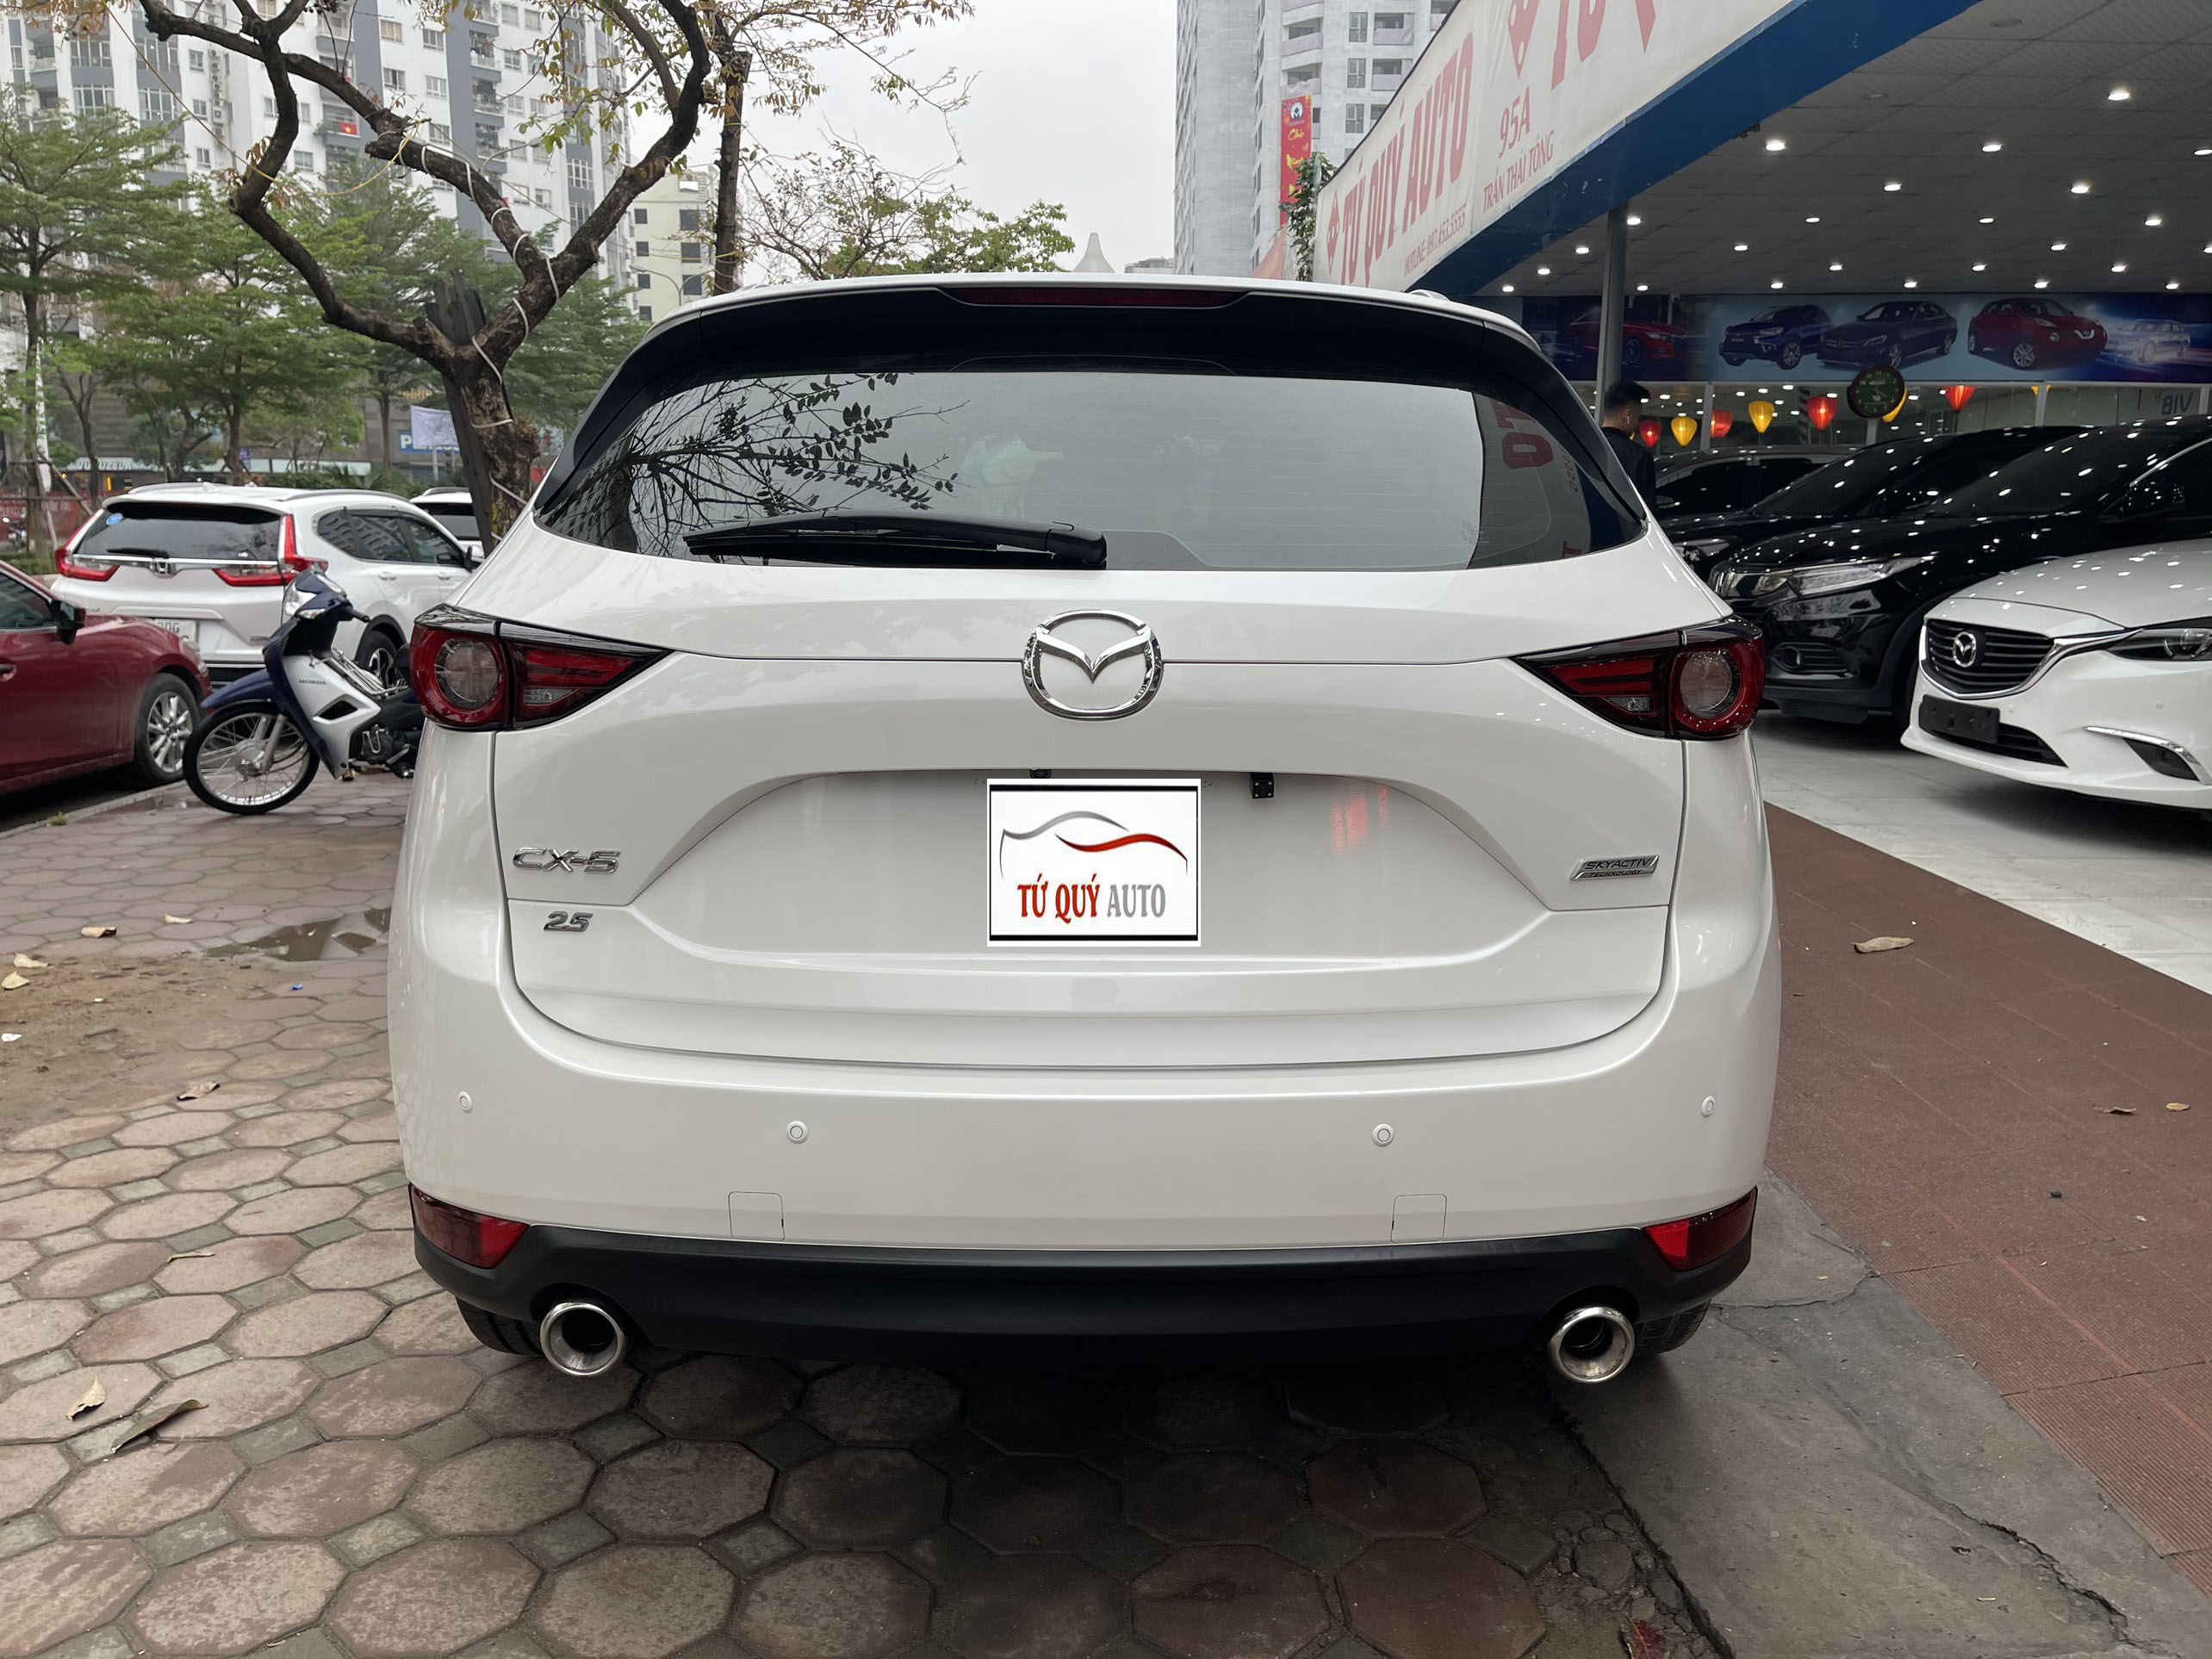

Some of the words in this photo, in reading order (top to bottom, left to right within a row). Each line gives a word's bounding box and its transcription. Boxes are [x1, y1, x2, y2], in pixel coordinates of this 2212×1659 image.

[1498, 85, 1531, 159] 95A
[1364, 96, 1406, 289] QUÝ
[1401, 31, 1474, 235] AUTO
[512, 847, 622, 874] CX-5
[1584, 858, 1652, 870] SKYACTIV
[1589, 868, 1641, 878] TECHNOLOGY
